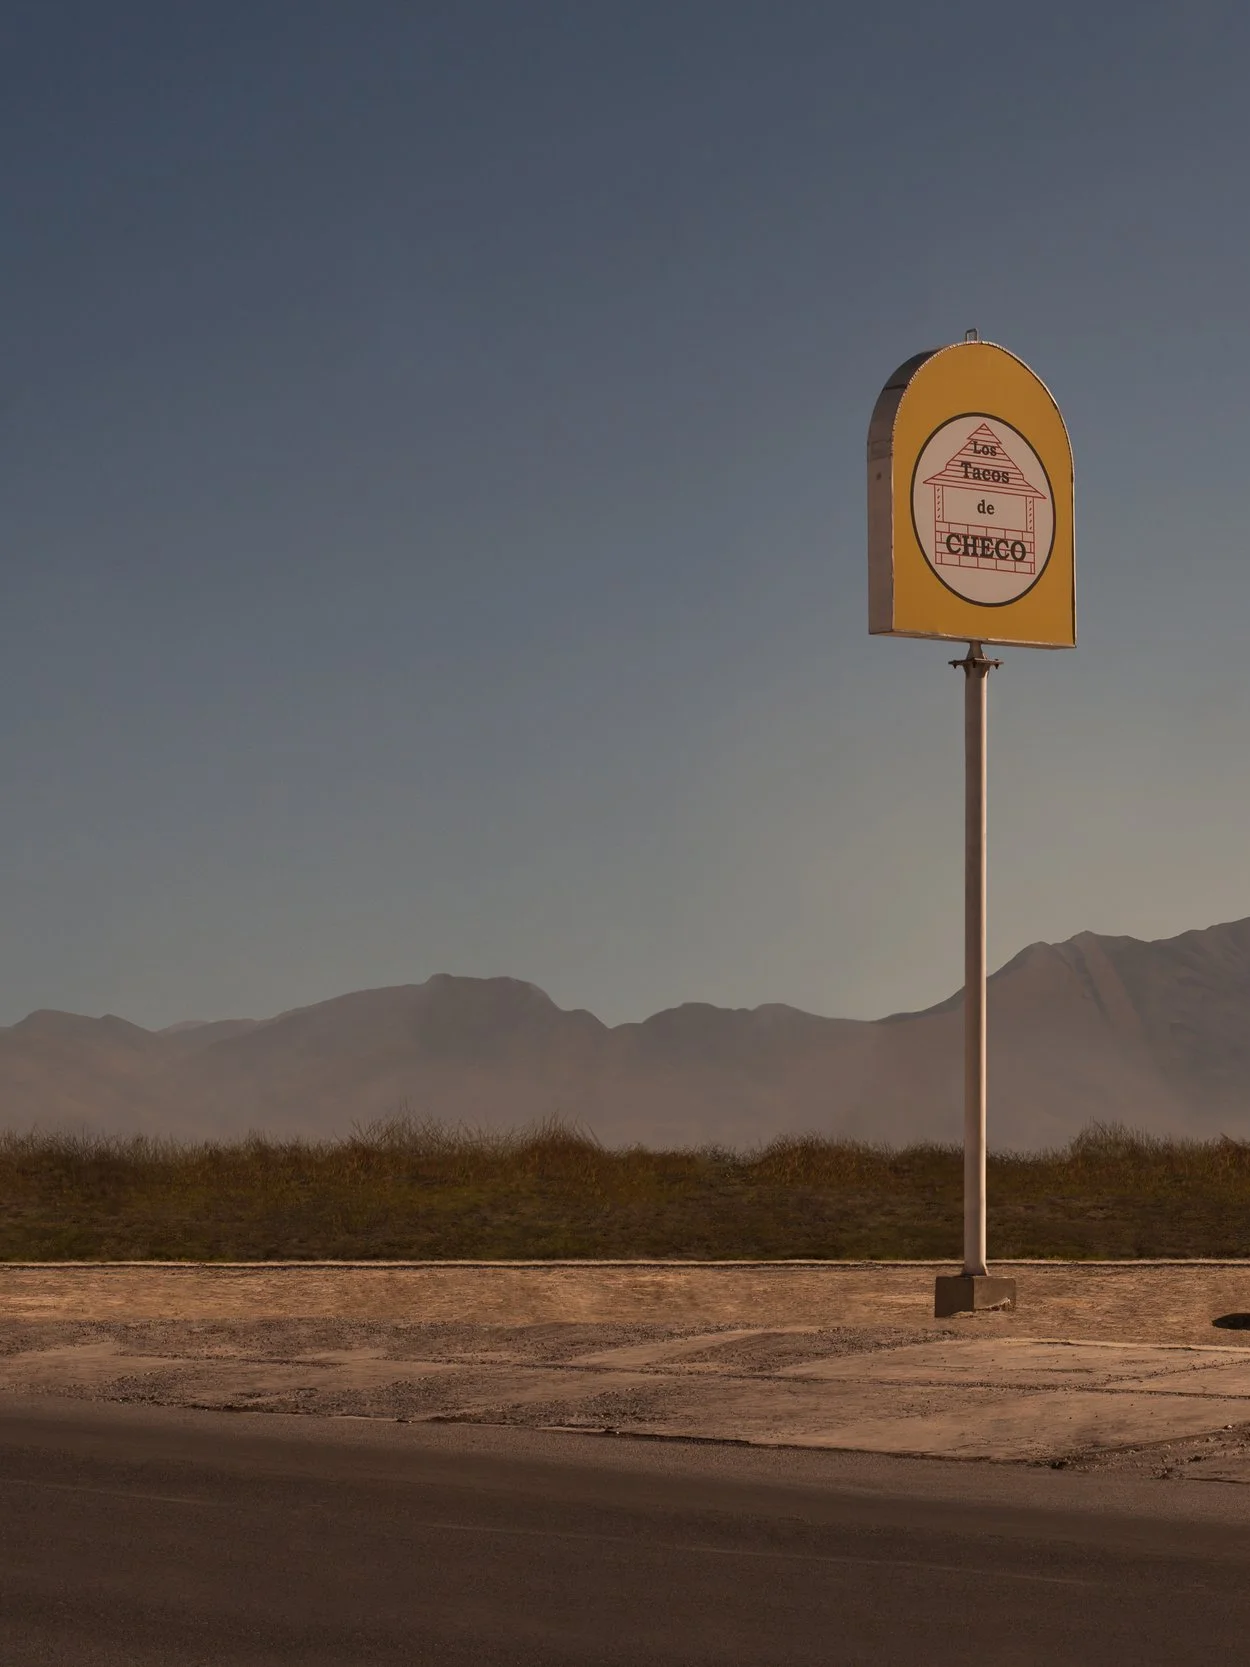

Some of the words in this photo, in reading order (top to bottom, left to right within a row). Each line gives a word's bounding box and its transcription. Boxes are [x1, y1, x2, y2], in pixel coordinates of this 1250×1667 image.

[972, 441, 997, 457] Los
[960, 461, 1010, 484] Tacos
[977, 499, 995, 515] de
[946, 533, 1027, 562] CHECO
